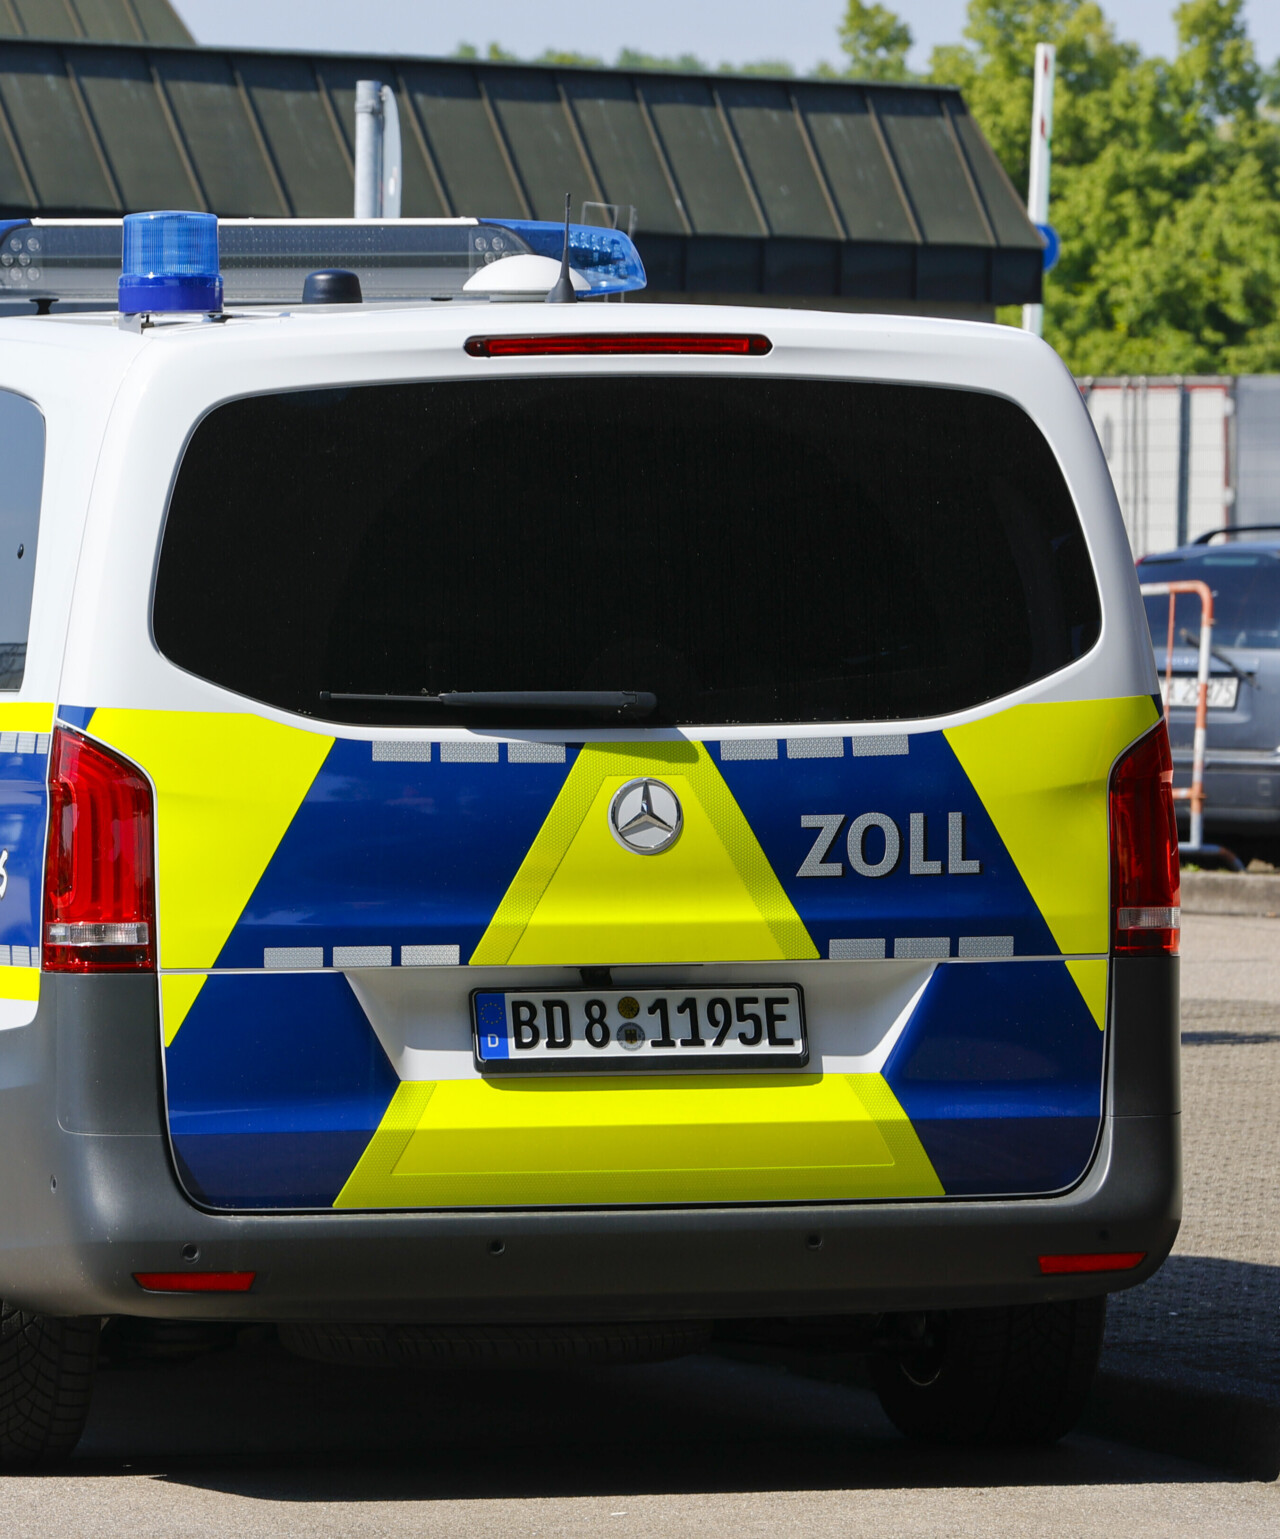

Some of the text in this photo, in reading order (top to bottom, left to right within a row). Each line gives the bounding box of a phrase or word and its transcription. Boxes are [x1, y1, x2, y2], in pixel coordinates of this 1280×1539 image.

[796, 812, 980, 877] ZOLL
[488, 1034, 499, 1047] D
[511, 999, 571, 1049] BD
[584, 999, 610, 1049] 8
[648, 997, 795, 1048] 1195E
